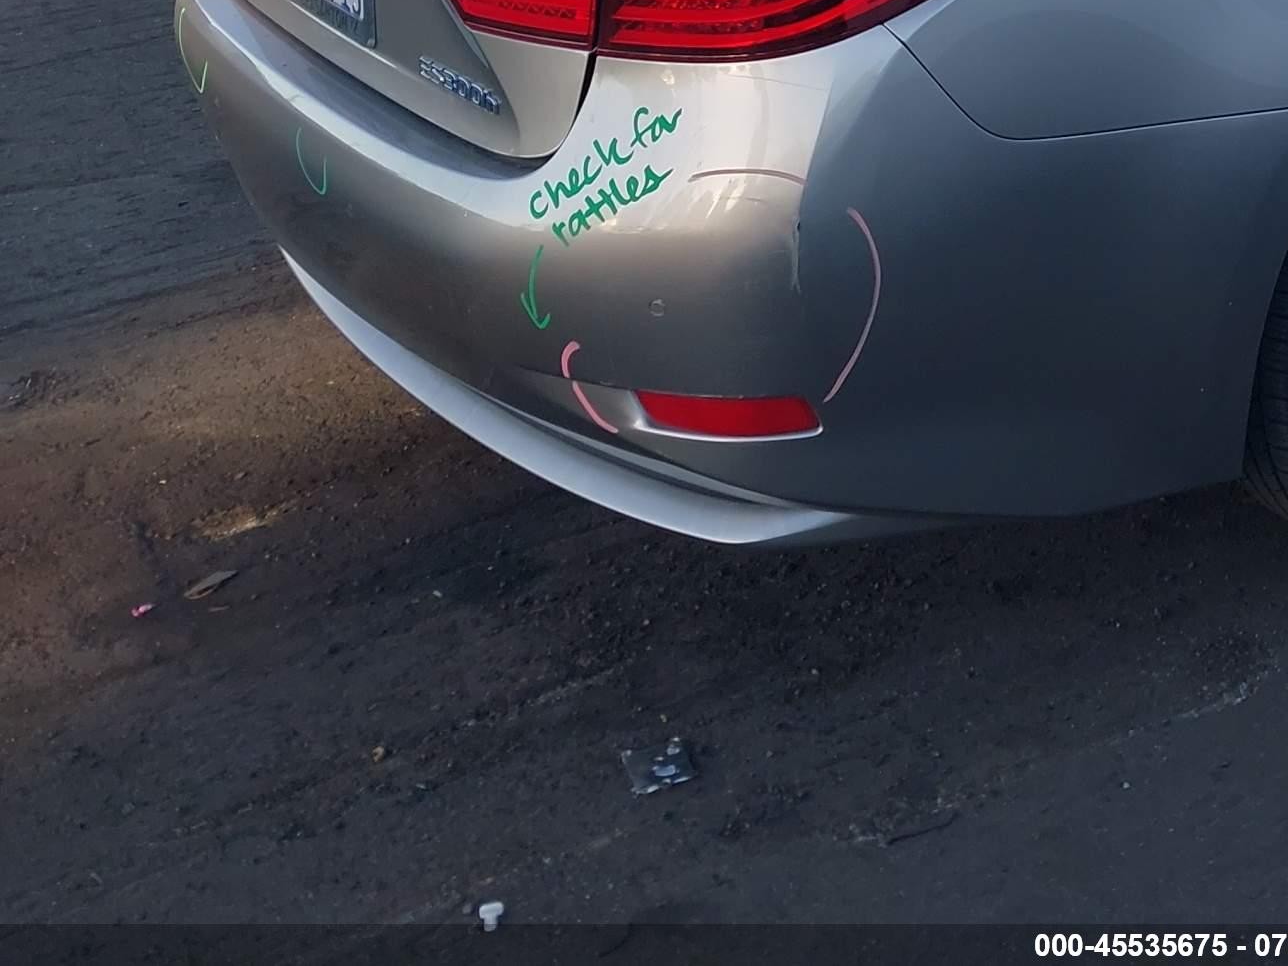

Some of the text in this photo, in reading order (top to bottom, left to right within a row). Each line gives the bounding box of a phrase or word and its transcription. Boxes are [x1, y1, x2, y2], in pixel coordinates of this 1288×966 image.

[530, 107, 683, 219] check for
[552, 165, 674, 246] rattles
